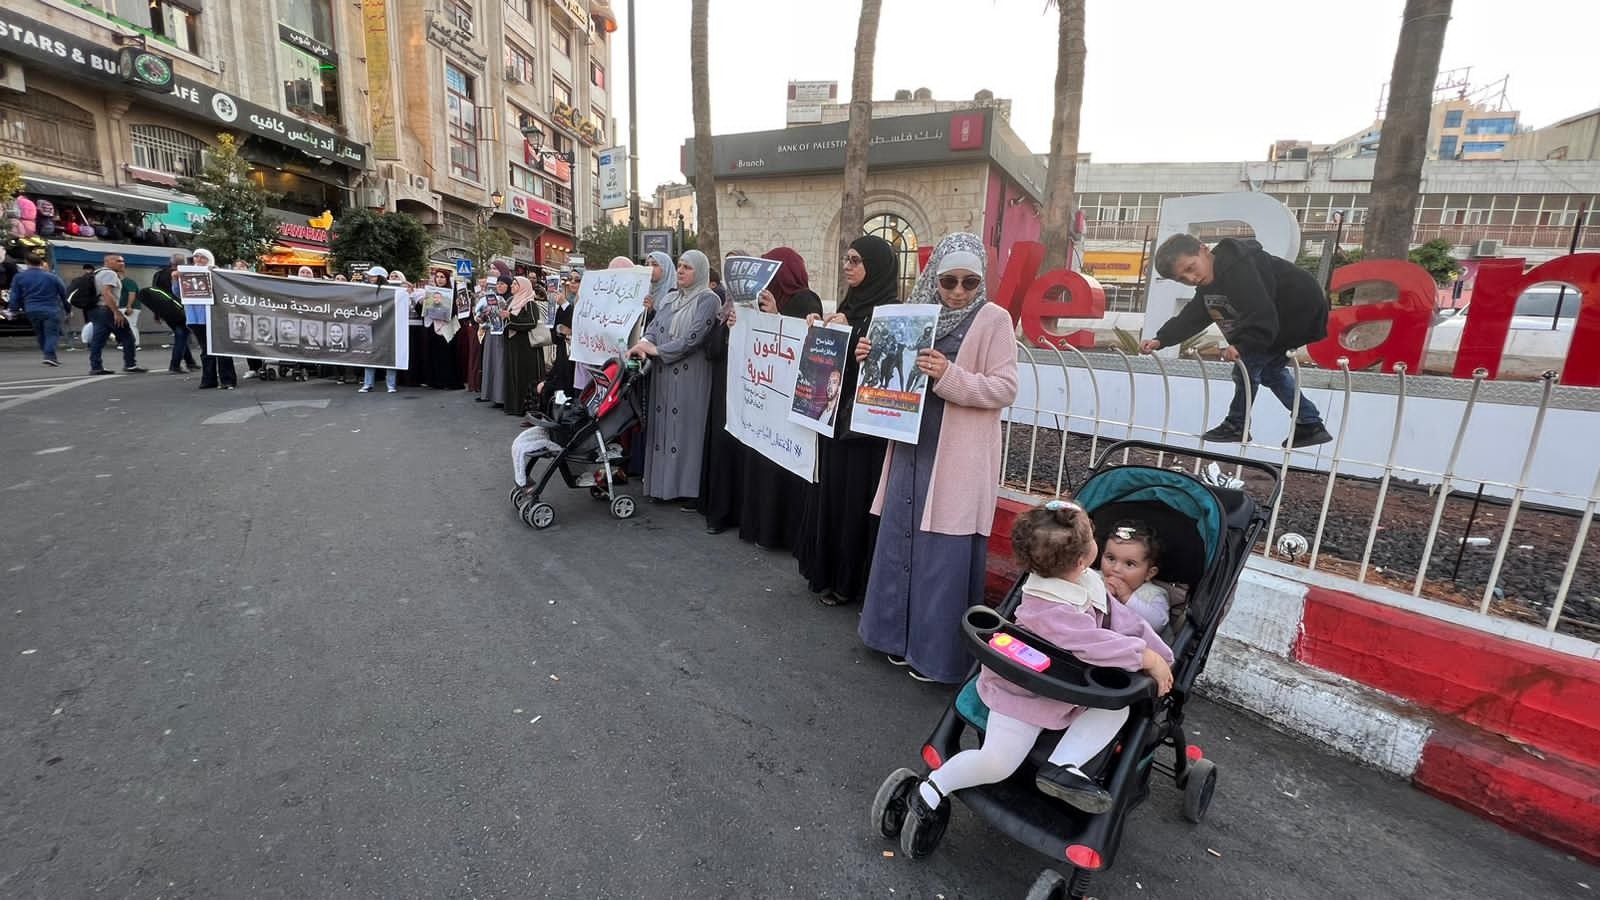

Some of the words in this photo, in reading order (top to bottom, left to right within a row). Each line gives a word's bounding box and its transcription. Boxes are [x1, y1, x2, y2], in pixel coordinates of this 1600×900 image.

[71, 48, 86, 65] &
[90, 53, 122, 75] BU
[250, 113, 285, 134] كافيه
[777, 143, 799, 153] BANK
[799, 142, 811, 152] OF
[812, 139, 848, 151] PALESTIN
[222, 293, 257, 308] للغاية
[258, 298, 288, 312] سيئة
[290, 300, 331, 314] الصحية
[333, 305, 383, 320] أوضاعهم
[753, 319, 796, 366] جائعون
[748, 358, 774, 386] للحرية
